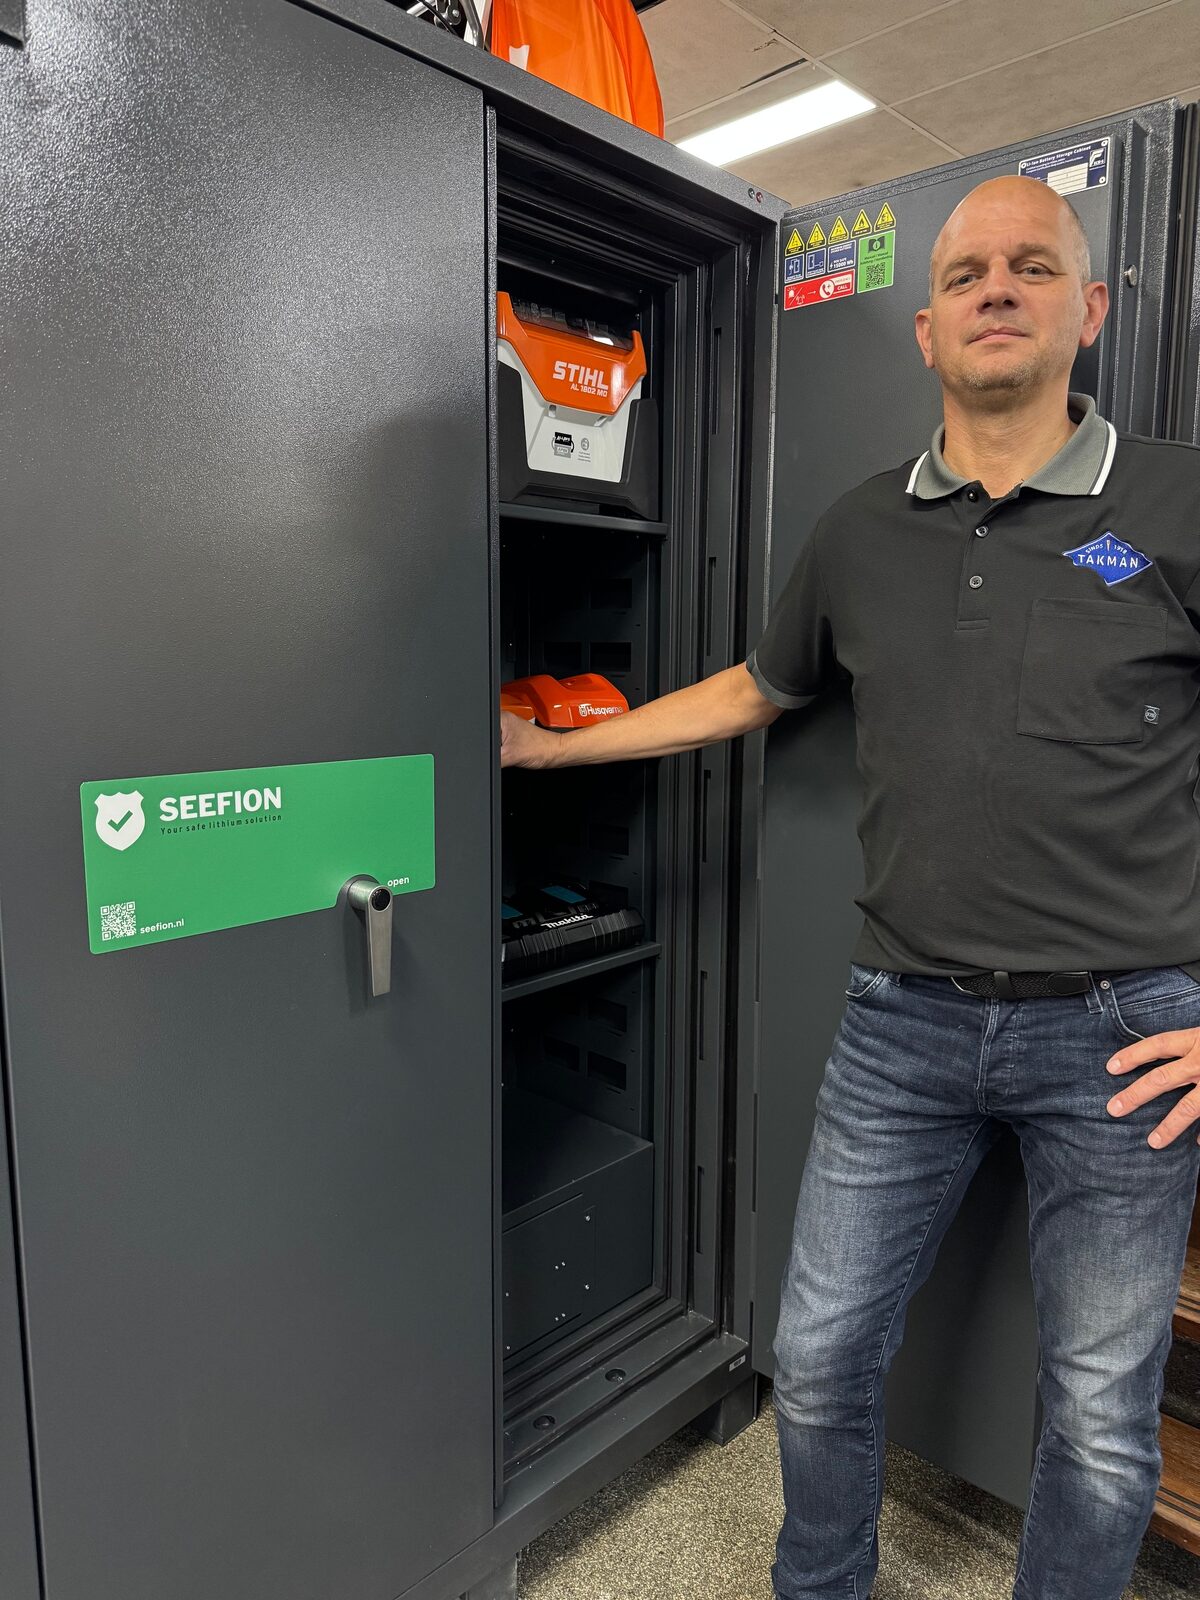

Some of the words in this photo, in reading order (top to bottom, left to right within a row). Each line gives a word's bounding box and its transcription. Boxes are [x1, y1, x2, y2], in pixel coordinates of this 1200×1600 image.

[553, 361, 608, 390] STIHL
[570, 383, 579, 391] AL
[1085, 544, 1103, 554] SINDS
[1078, 554, 1138, 568] TAKMAN
[586, 705, 624, 716] Husqvarna
[159, 786, 282, 822] SEEFION
[160, 826, 183, 835] Your
[186, 822, 206, 832] safe
[208, 819, 242, 829] lithium
[245, 814, 282, 825] solution
[387, 876, 410, 888] open
[140, 918, 185, 934] seefion.nl
